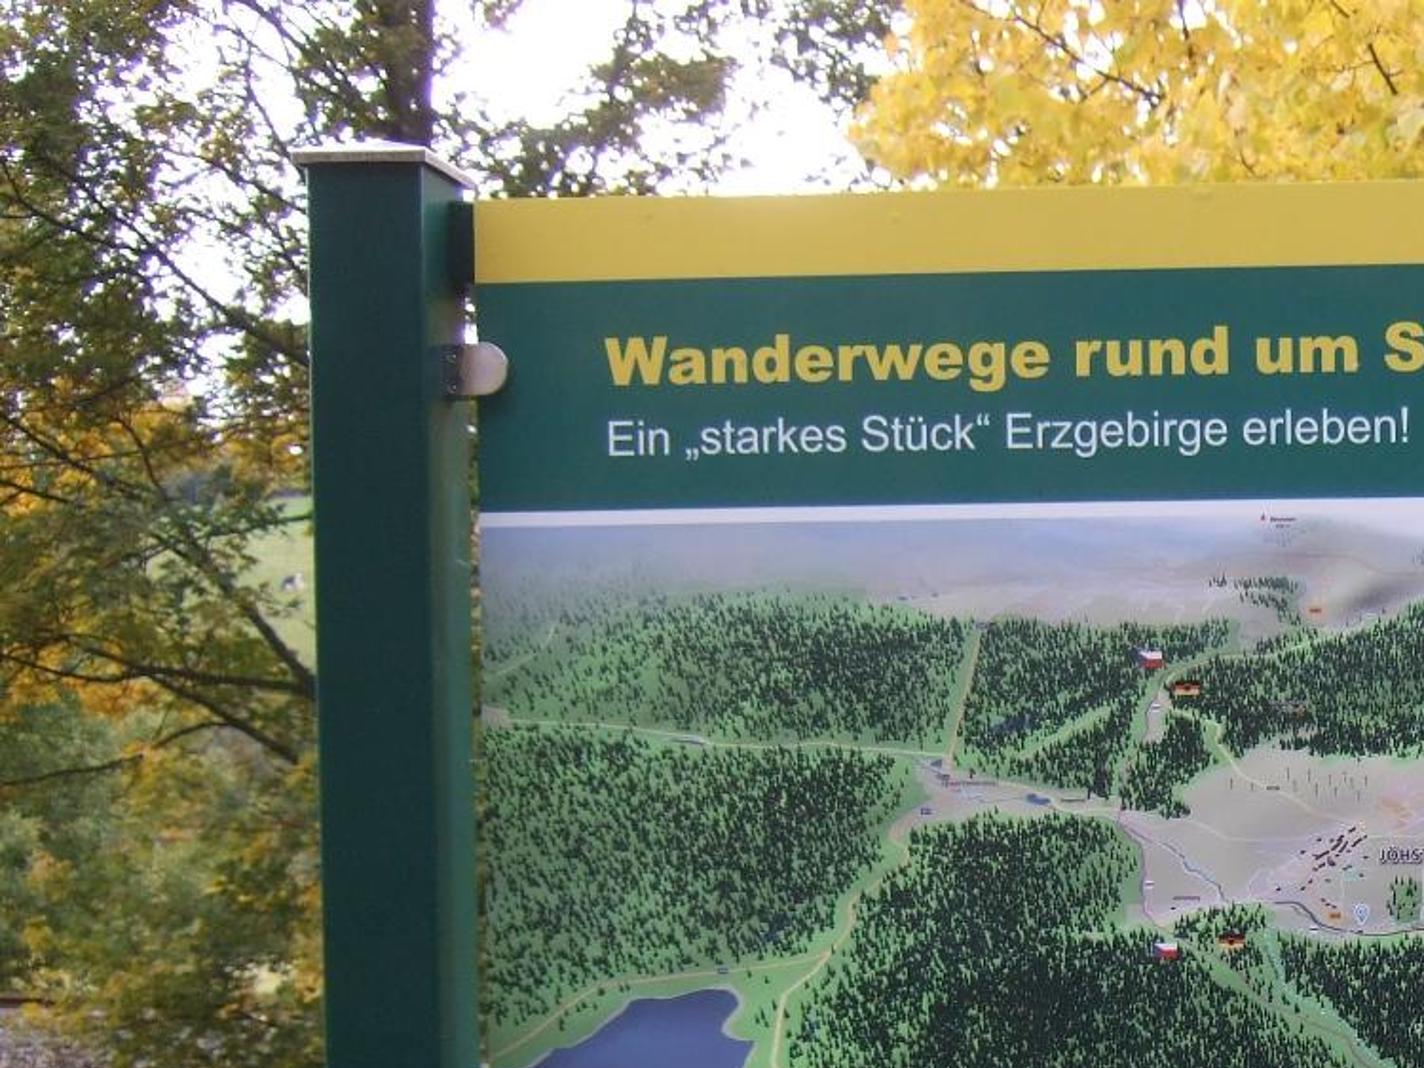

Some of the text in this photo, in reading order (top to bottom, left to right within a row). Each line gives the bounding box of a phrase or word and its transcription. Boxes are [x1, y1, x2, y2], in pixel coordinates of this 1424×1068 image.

[604, 334, 1050, 393] Wanderwege
[1074, 325, 1231, 378] rund
[1255, 335, 1361, 375] um
[607, 405, 1409, 461] Ein „starkes Stück“ Erzgebirge erleben!
